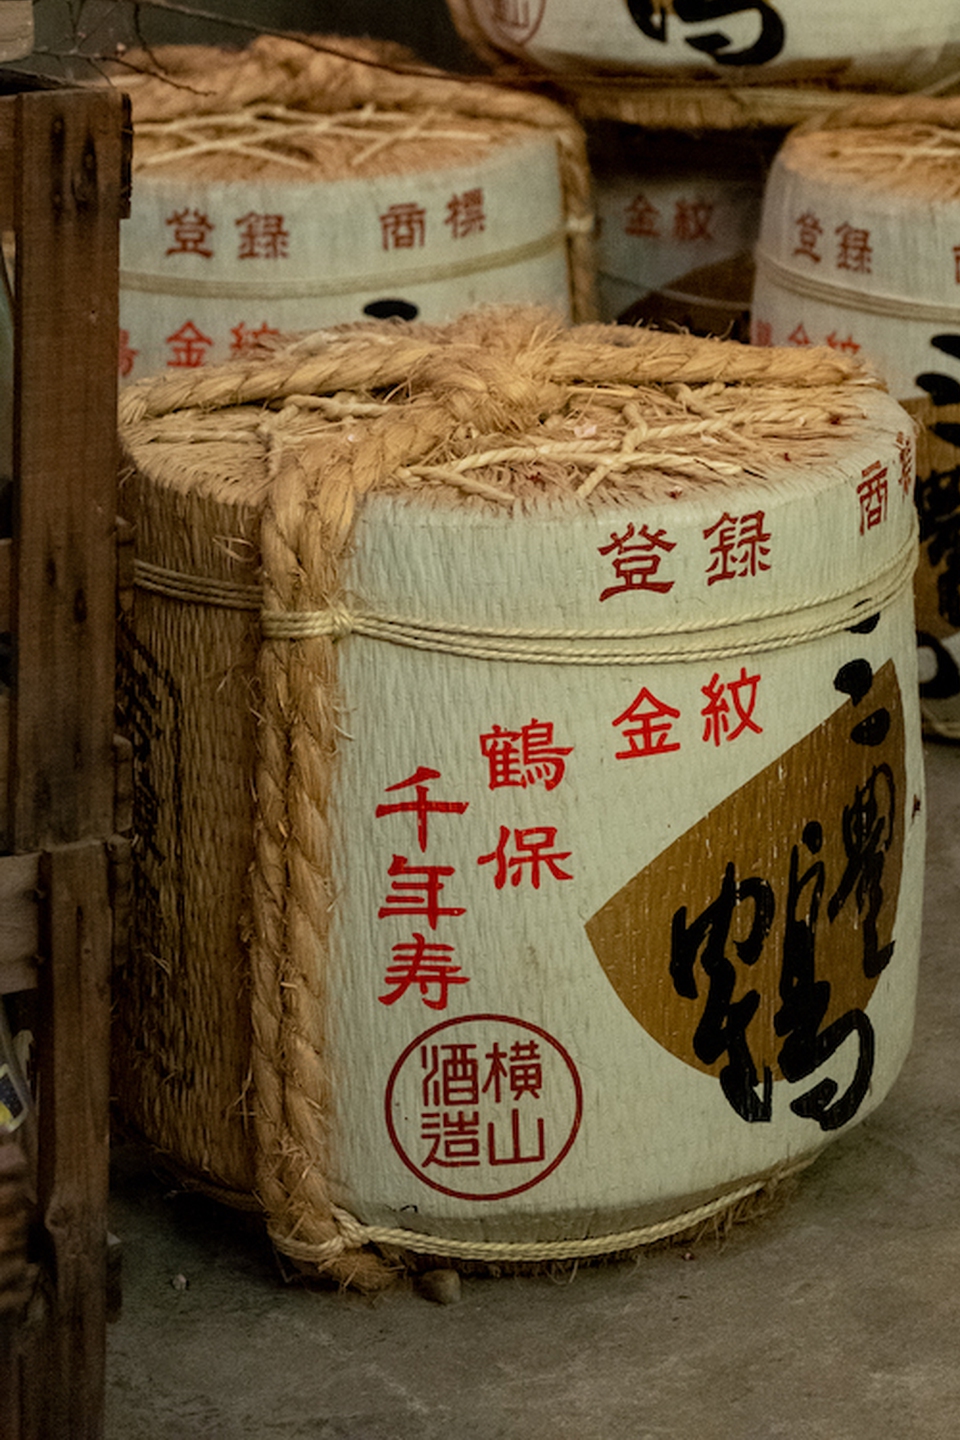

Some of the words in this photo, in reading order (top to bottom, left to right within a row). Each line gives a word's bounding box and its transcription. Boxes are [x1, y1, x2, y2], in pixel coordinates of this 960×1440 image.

[164, 206, 292, 261] 登録
[378, 187, 487, 252] 商標
[793, 212, 873, 275] 登録
[597, 510, 772, 602] 登録
[611, 667, 763, 760] 金紋
[477, 717, 575, 890] 鶴保
[375, 765, 471, 1011] 千年寿
